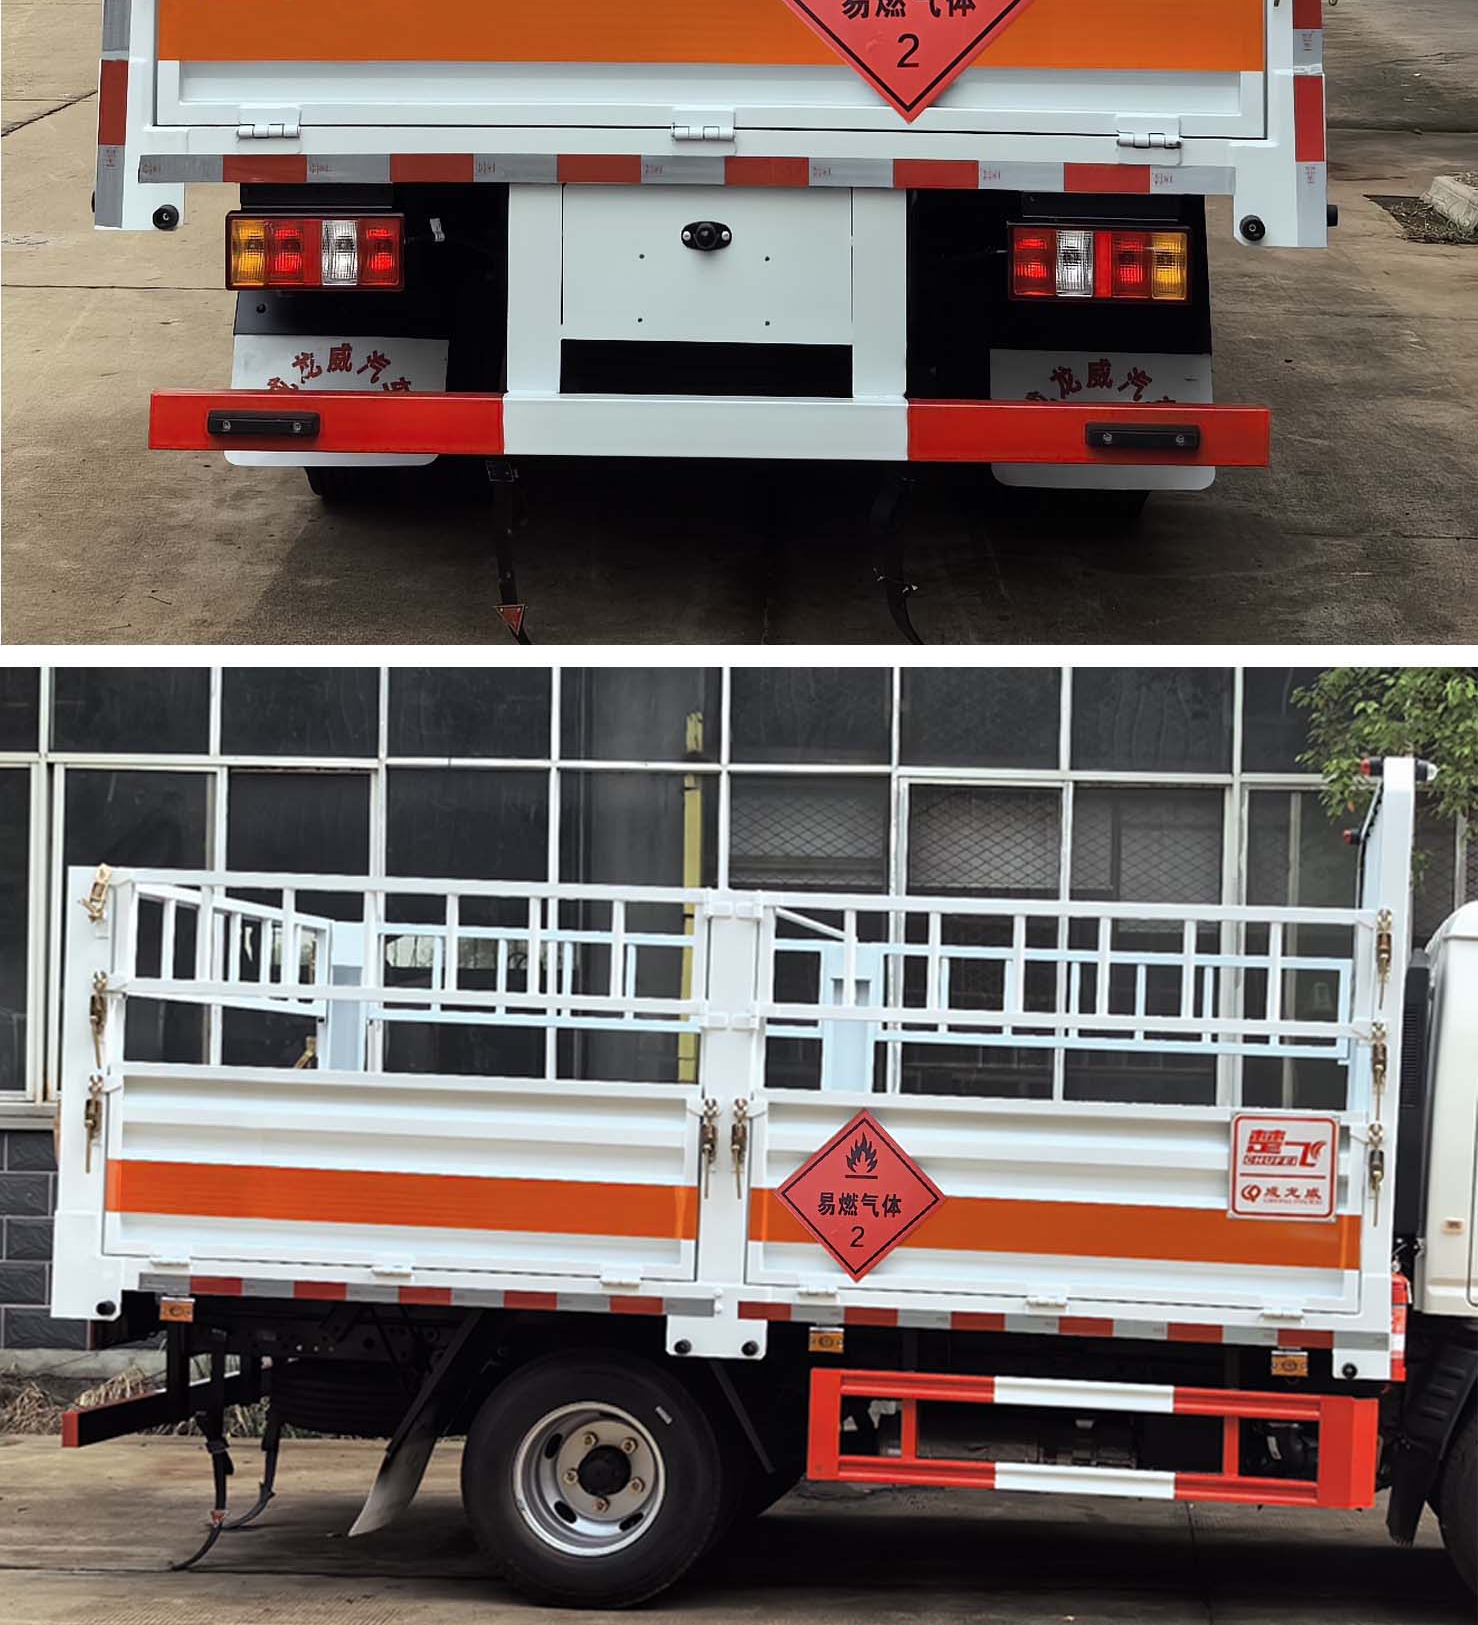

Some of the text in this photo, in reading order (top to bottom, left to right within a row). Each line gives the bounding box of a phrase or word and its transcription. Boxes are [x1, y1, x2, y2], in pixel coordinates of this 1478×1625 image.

[896, 33, 920, 68] 2
[267, 342, 412, 391] 龙威汽
[1025, 357, 1176, 403] 龙威汽
[817, 1192, 902, 1218] 易燃气体
[849, 1225, 866, 1248] 2
